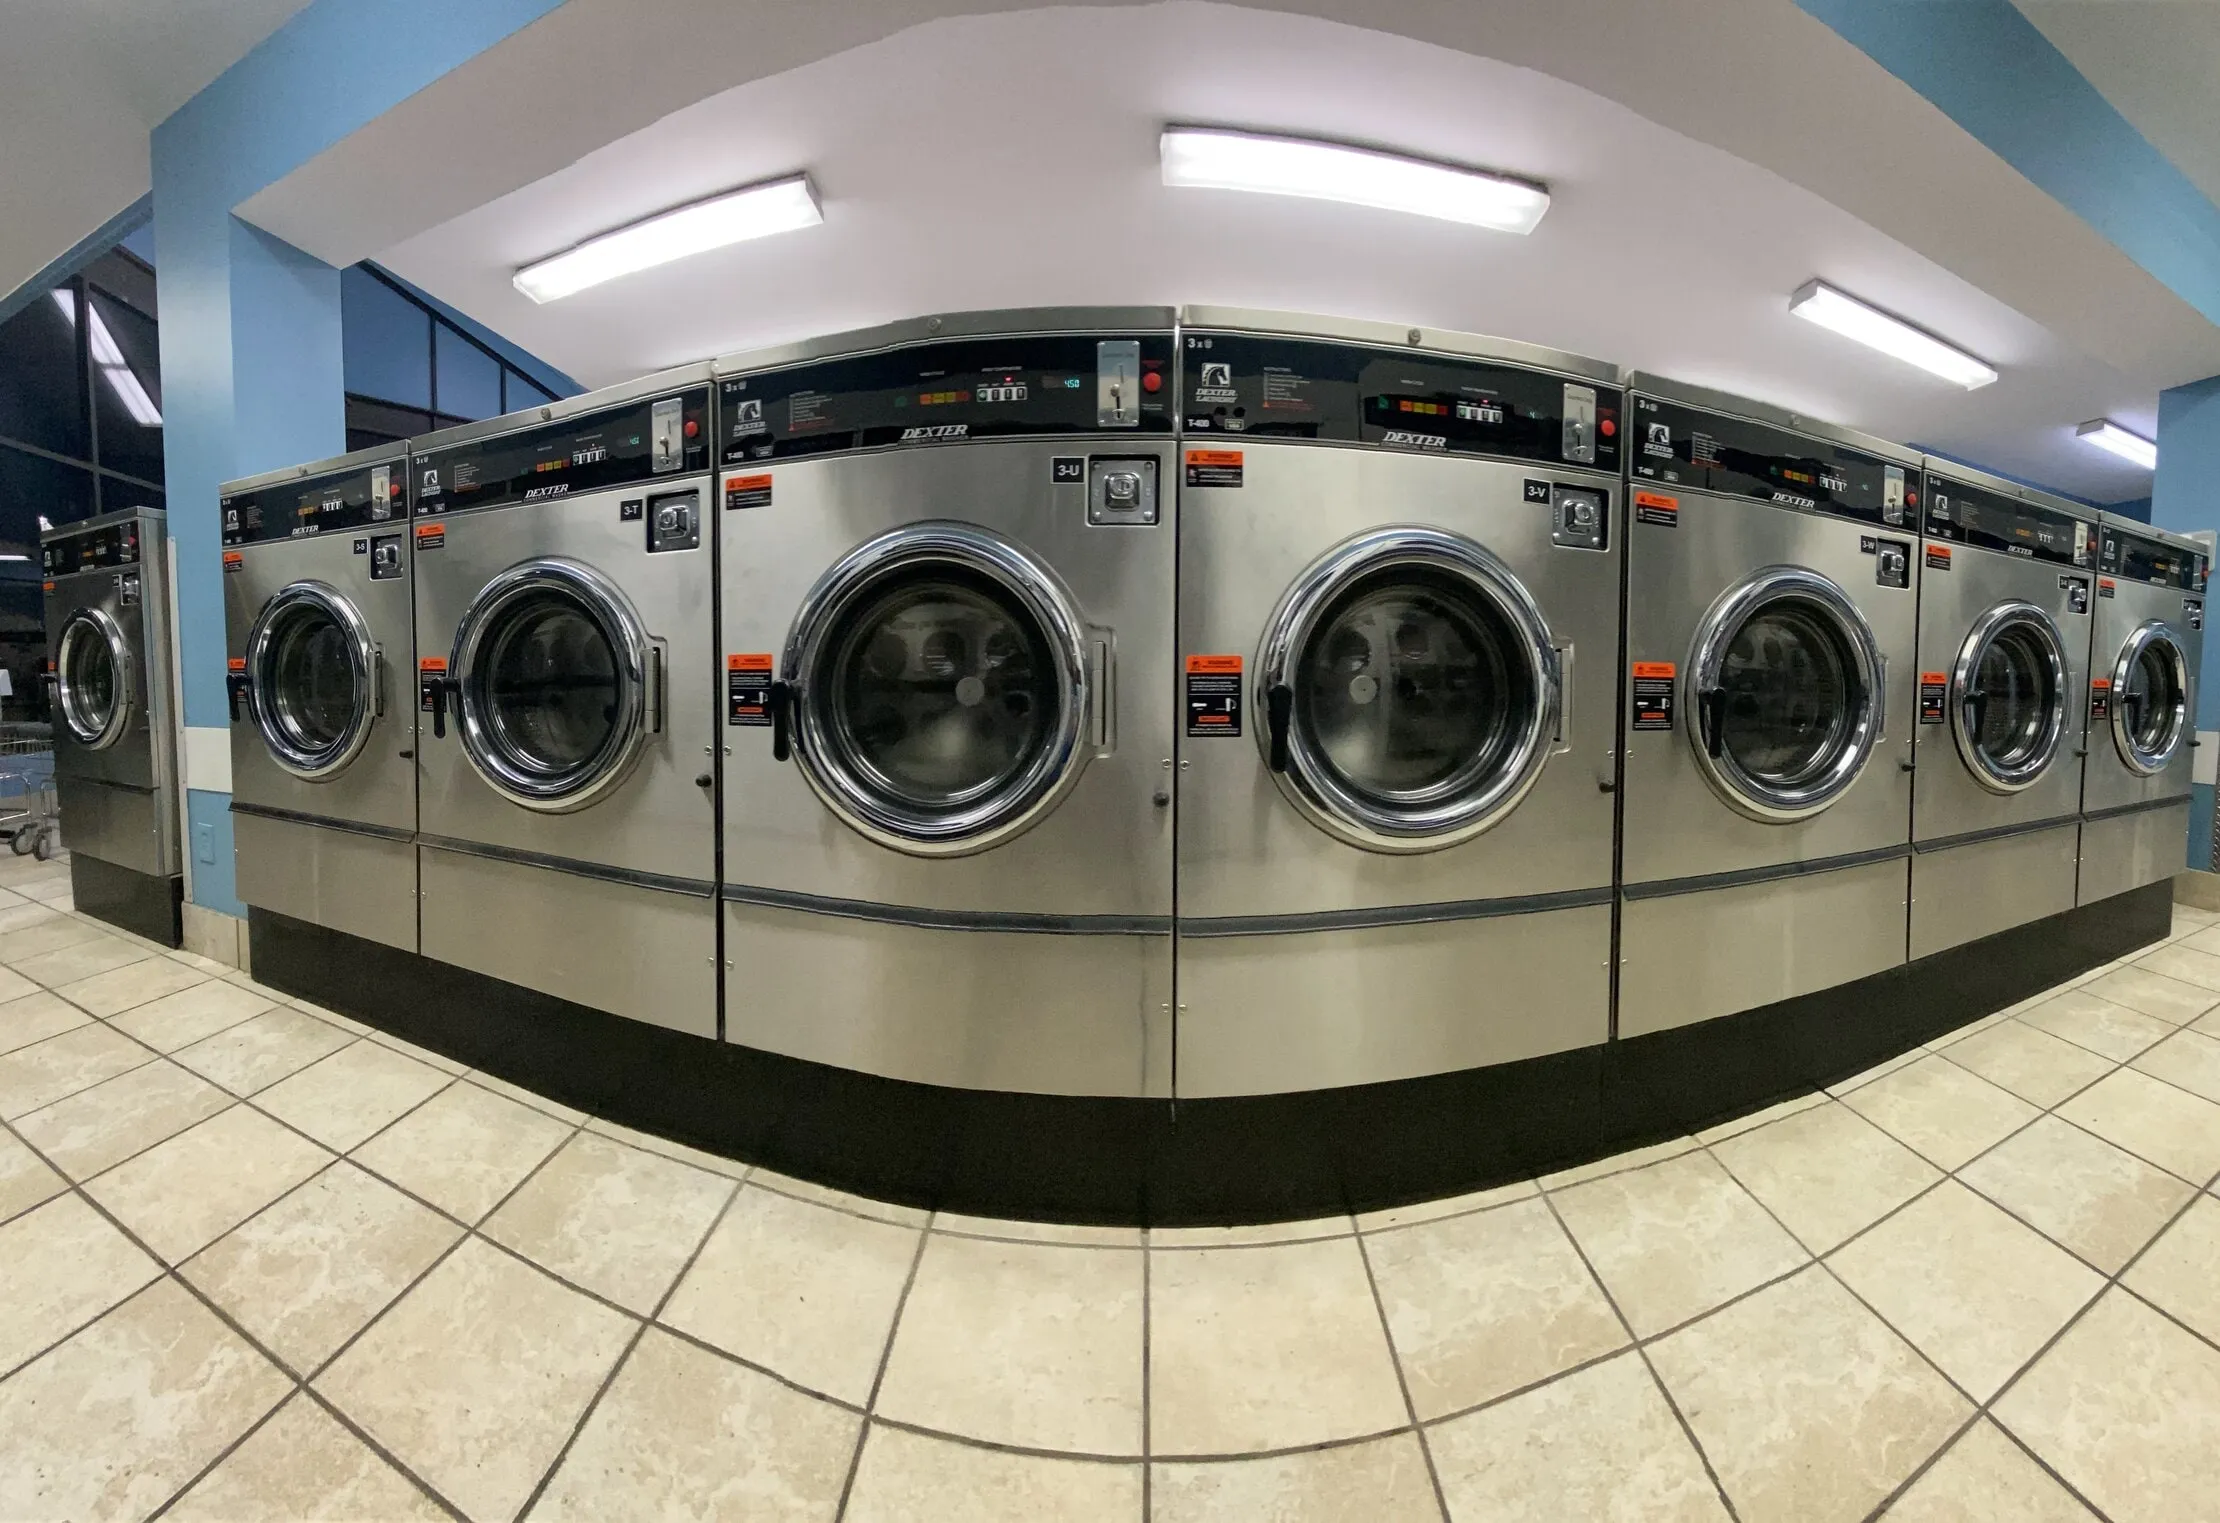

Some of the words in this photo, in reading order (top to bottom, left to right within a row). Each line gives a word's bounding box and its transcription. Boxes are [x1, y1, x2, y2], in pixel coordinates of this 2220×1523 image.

[900, 424, 969, 440] DEXTER
[1382, 431, 1448, 447] DEXTER
[1057, 464, 1081, 477] 3-U
[524, 483, 569, 500] DEXTER
[1527, 485, 1547, 498] 3-V
[1771, 492, 1816, 509] DEXTER
[623, 504, 639, 516] 3-T
[291, 524, 320, 536] DEXTER
[2007, 544, 2034, 556] DEXTER
